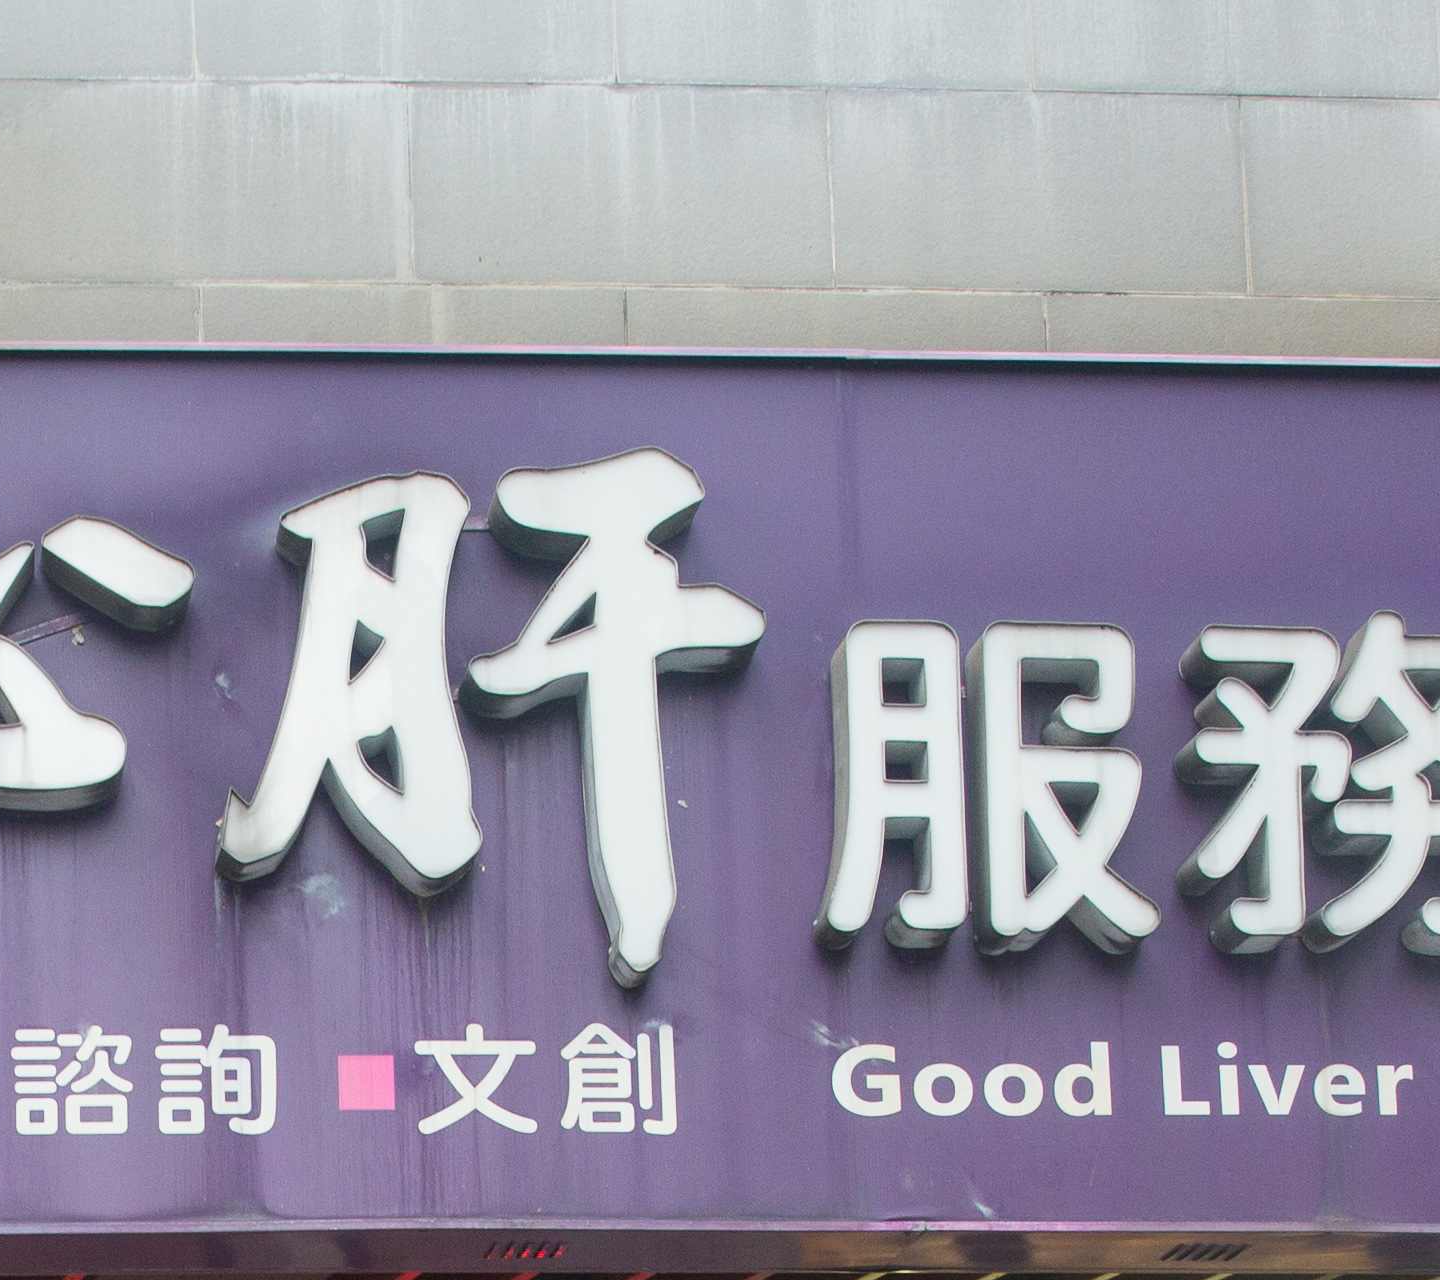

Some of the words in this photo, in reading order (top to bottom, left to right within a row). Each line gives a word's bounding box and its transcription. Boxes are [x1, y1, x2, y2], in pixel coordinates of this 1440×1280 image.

[12, 1026, 277, 1136] 諮詢
[415, 1023, 678, 1136] 文創
[830, 1041, 1113, 1119] Good
[1162, 1041, 1413, 1118] Liver
